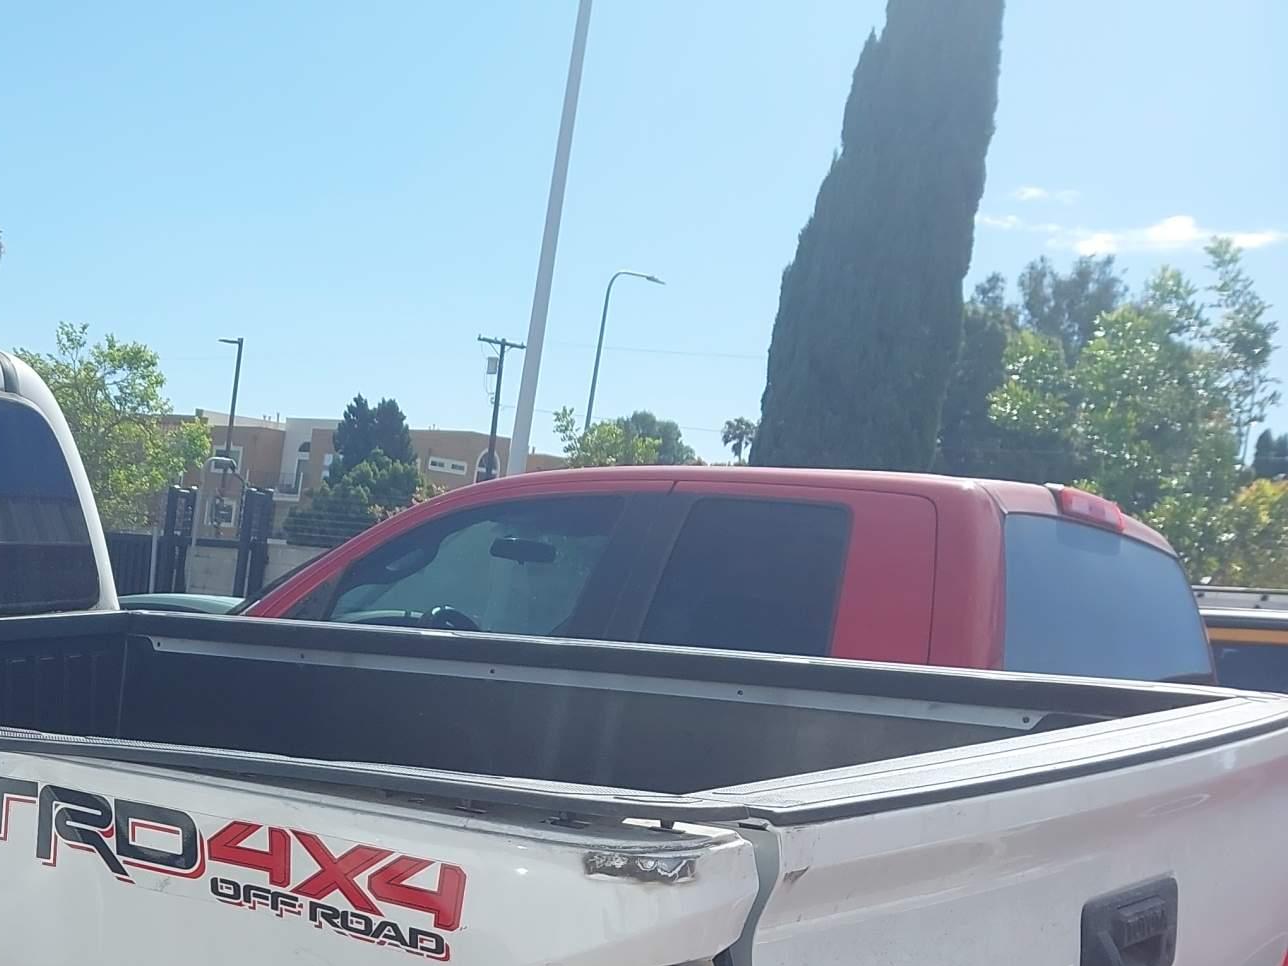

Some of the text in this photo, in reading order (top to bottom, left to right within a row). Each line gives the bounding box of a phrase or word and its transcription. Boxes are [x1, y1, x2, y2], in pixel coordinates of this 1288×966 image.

[207, 821, 467, 931] 4X4
[210, 877, 450, 961] OFF ROAD
